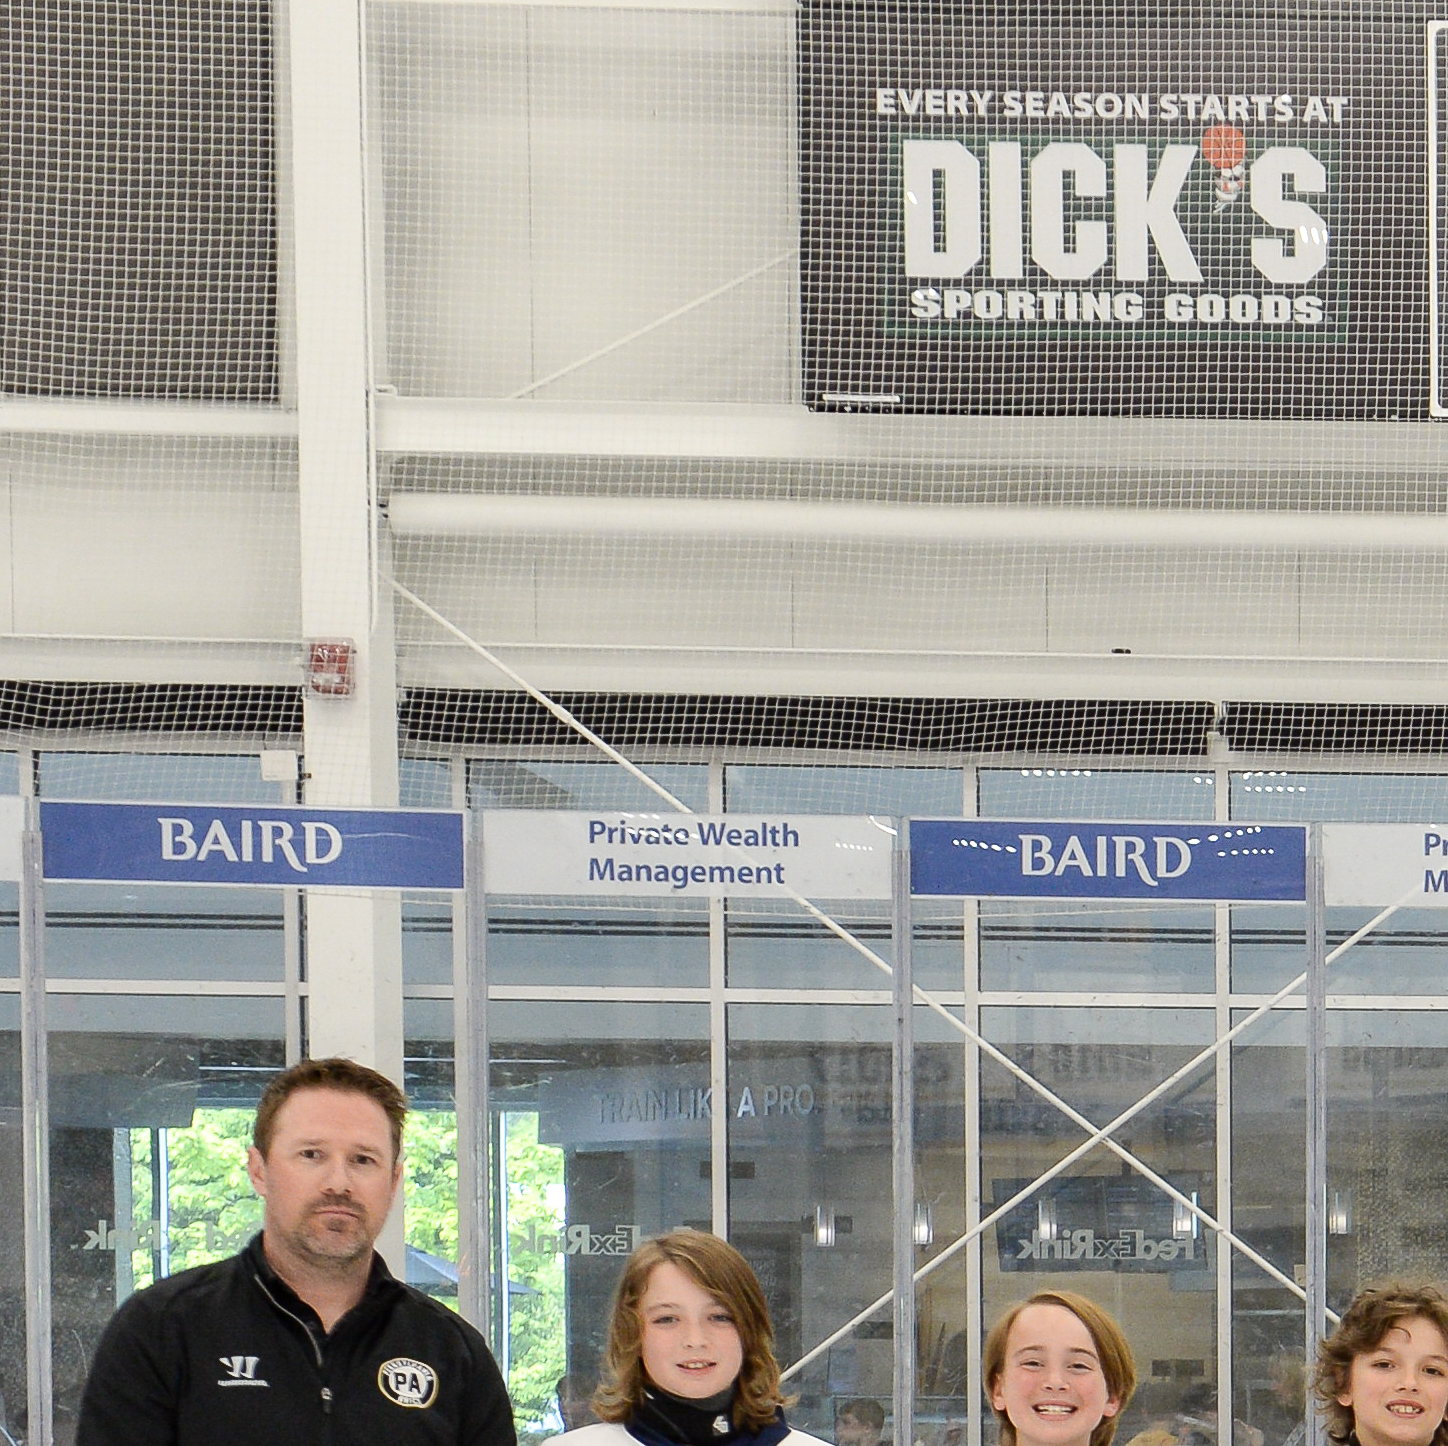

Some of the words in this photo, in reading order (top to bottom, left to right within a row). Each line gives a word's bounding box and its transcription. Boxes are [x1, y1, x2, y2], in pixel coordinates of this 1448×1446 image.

[876, 89, 992, 116] EVERY
[1003, 91, 1147, 119] SEASON
[1159, 94, 1293, 122] STARTS
[1303, 97, 1350, 122] AT
[910, 289, 1143, 323] SPORTING
[1164, 292, 1326, 325] GOODS
[156, 817, 343, 873] BAIRD
[588, 820, 690, 849] Private
[697, 821, 800, 848] Wealth
[588, 858, 786, 890] Management
[1018, 834, 1192, 888] BAIRD
[677, 1087, 712, 1120] LIK
[393, 1371, 421, 1395] PA
